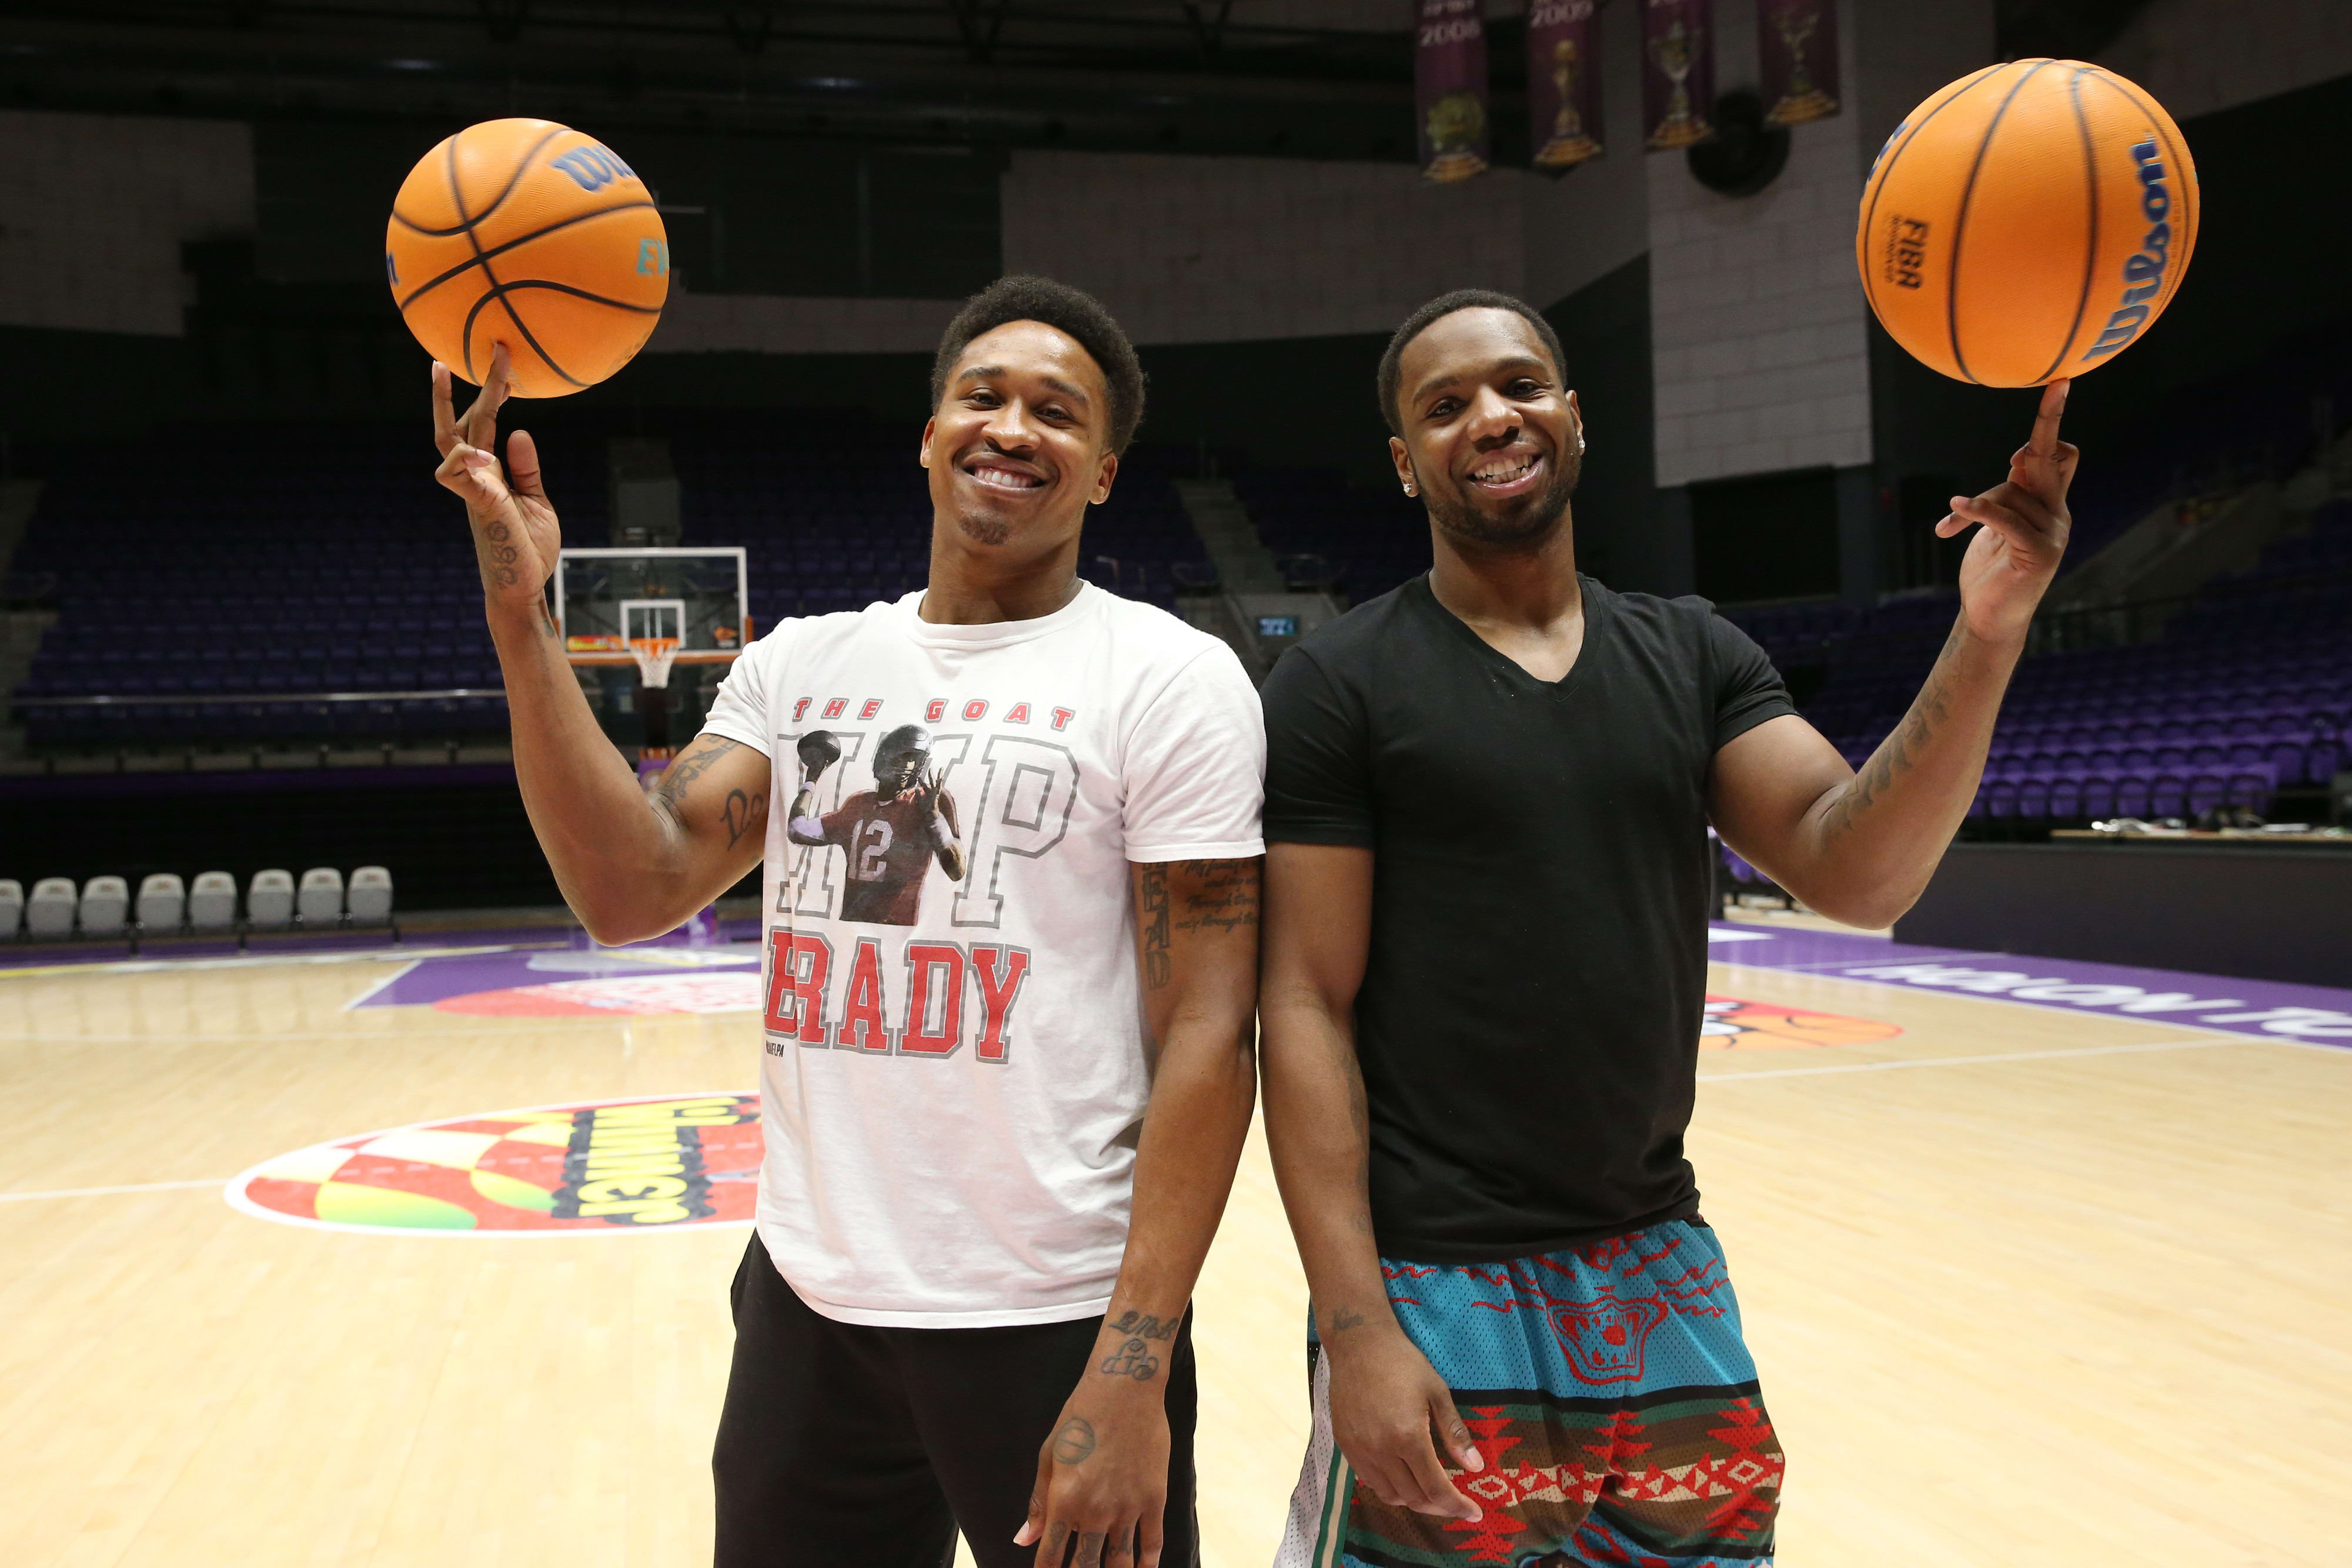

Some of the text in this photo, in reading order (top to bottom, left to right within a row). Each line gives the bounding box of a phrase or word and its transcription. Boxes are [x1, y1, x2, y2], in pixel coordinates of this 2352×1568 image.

[2081, 135, 2171, 362] Wilson
[792, 697, 1075, 732] THE GOAT
[849, 818, 893, 882] 12
[764, 925, 1031, 1064] BRADY
